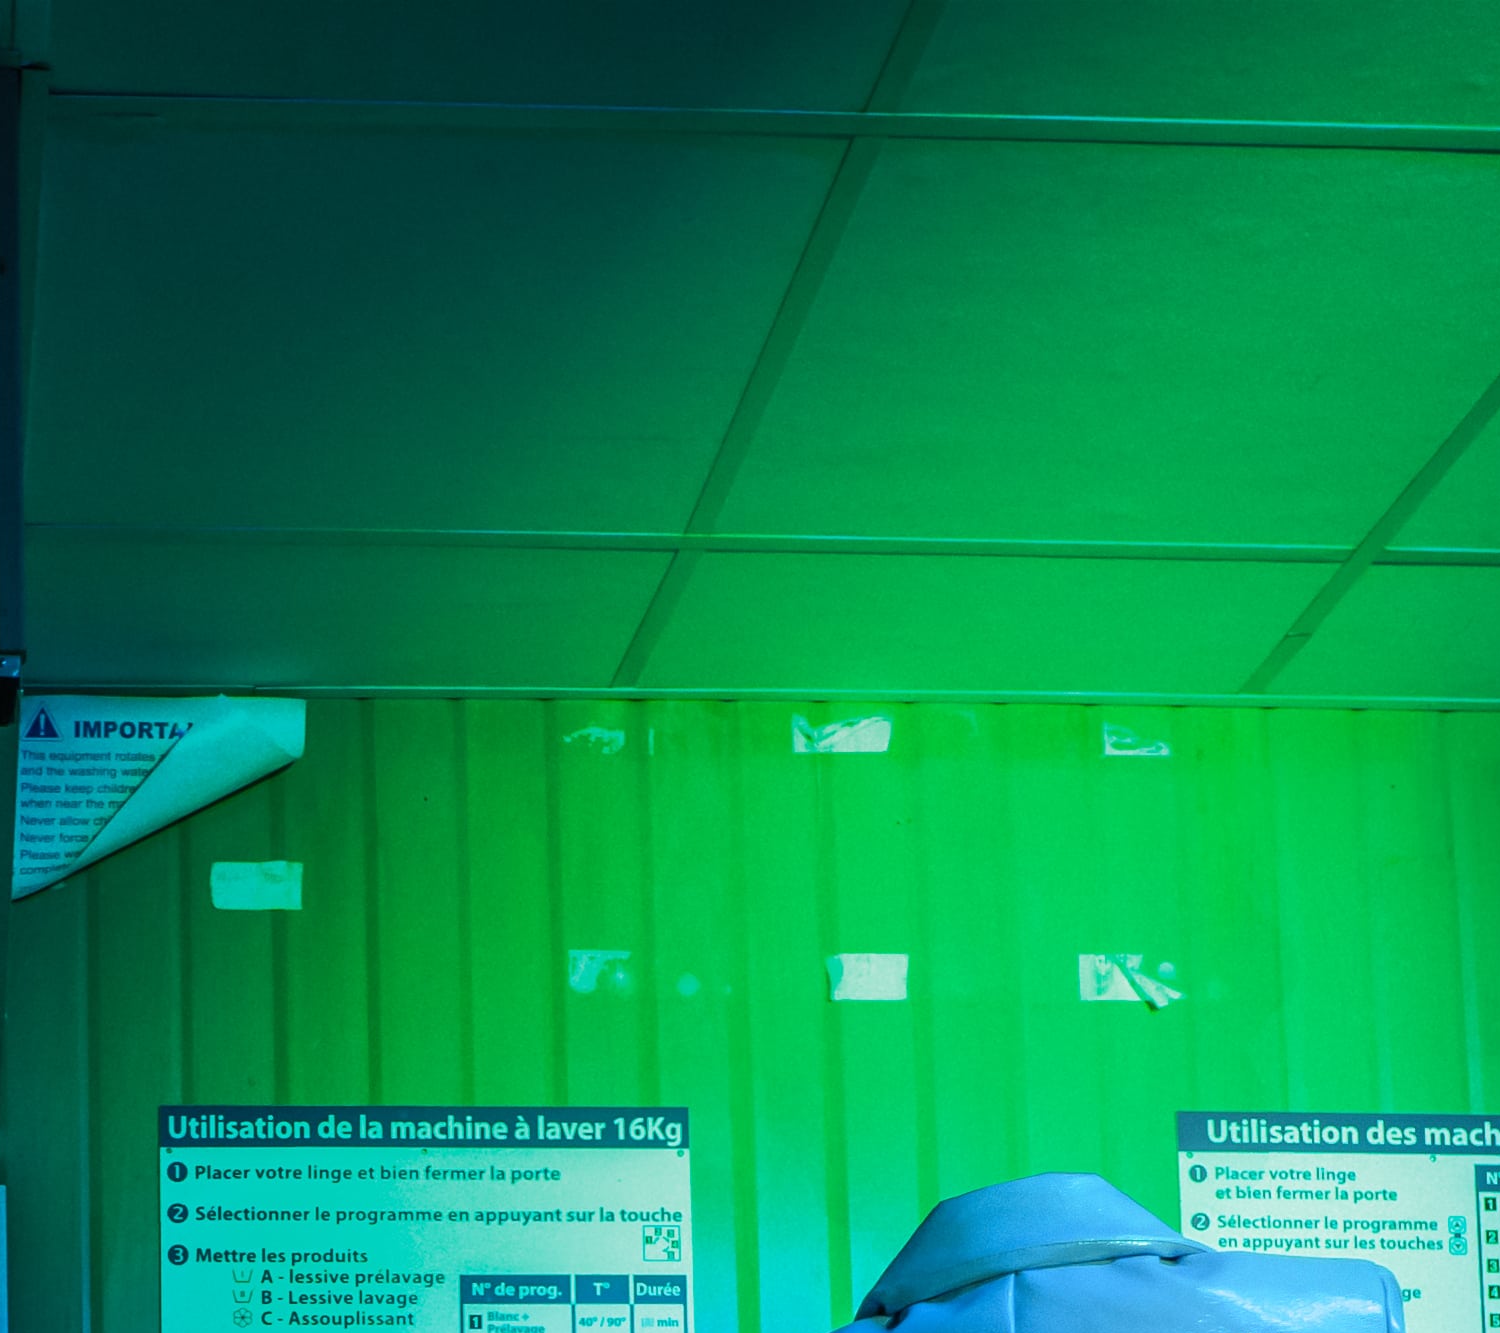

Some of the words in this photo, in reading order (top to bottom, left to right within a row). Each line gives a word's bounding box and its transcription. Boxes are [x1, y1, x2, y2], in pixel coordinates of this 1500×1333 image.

[73, 719, 194, 740] IMPORTA
[167, 1113, 311, 1140] Utilisation
[316, 1113, 353, 1139] de
[358, 1113, 383, 1139] la
[389, 1114, 508, 1140] machine
[513, 1114, 531, 1140] à
[536, 1114, 606, 1141] laver
[612, 1115, 683, 1147] 16Kg
[1206, 1117, 1359, 1145] Utilisation
[1365, 1118, 1417, 1146] des
[194, 1164, 250, 1180] Placer
[254, 1165, 302, 1179] votre
[307, 1164, 352, 1184] linge
[357, 1166, 375, 1180] et
[379, 1164, 419, 1180] bien
[424, 1164, 485, 1180] fermer
[490, 1165, 505, 1180] la
[510, 1167, 560, 1184] porte
[1214, 1165, 1265, 1180] Placer
[1268, 1168, 1311, 1180] votre
[1315, 1166, 1356, 1185] linge
[1214, 1186, 1231, 1199] et
[1235, 1185, 1272, 1199] bien
[1275, 1185, 1330, 1200] fermer
[1334, 1185, 1349, 1200] la
[1352, 1188, 1397, 1204] porte
[194, 1205, 310, 1221] Sélectionner
[314, 1205, 331, 1221] le
[335, 1209, 442, 1225] programme
[447, 1210, 469, 1222] en
[474, 1208, 561, 1225] appuyant
[566, 1210, 595, 1222] sur
[599, 1206, 615, 1222] la
[619, 1206, 682, 1222] touche
[1216, 1214, 1320, 1229] Sélectionner
[1323, 1215, 1338, 1229] le
[1342, 1219, 1438, 1233] programme
[1217, 1237, 1238, 1248] en
[1241, 1236, 1320, 1252] appuyant
[1324, 1238, 1350, 1249] sur
[1353, 1234, 1376, 1250] les
[1379, 1235, 1443, 1250] touches
